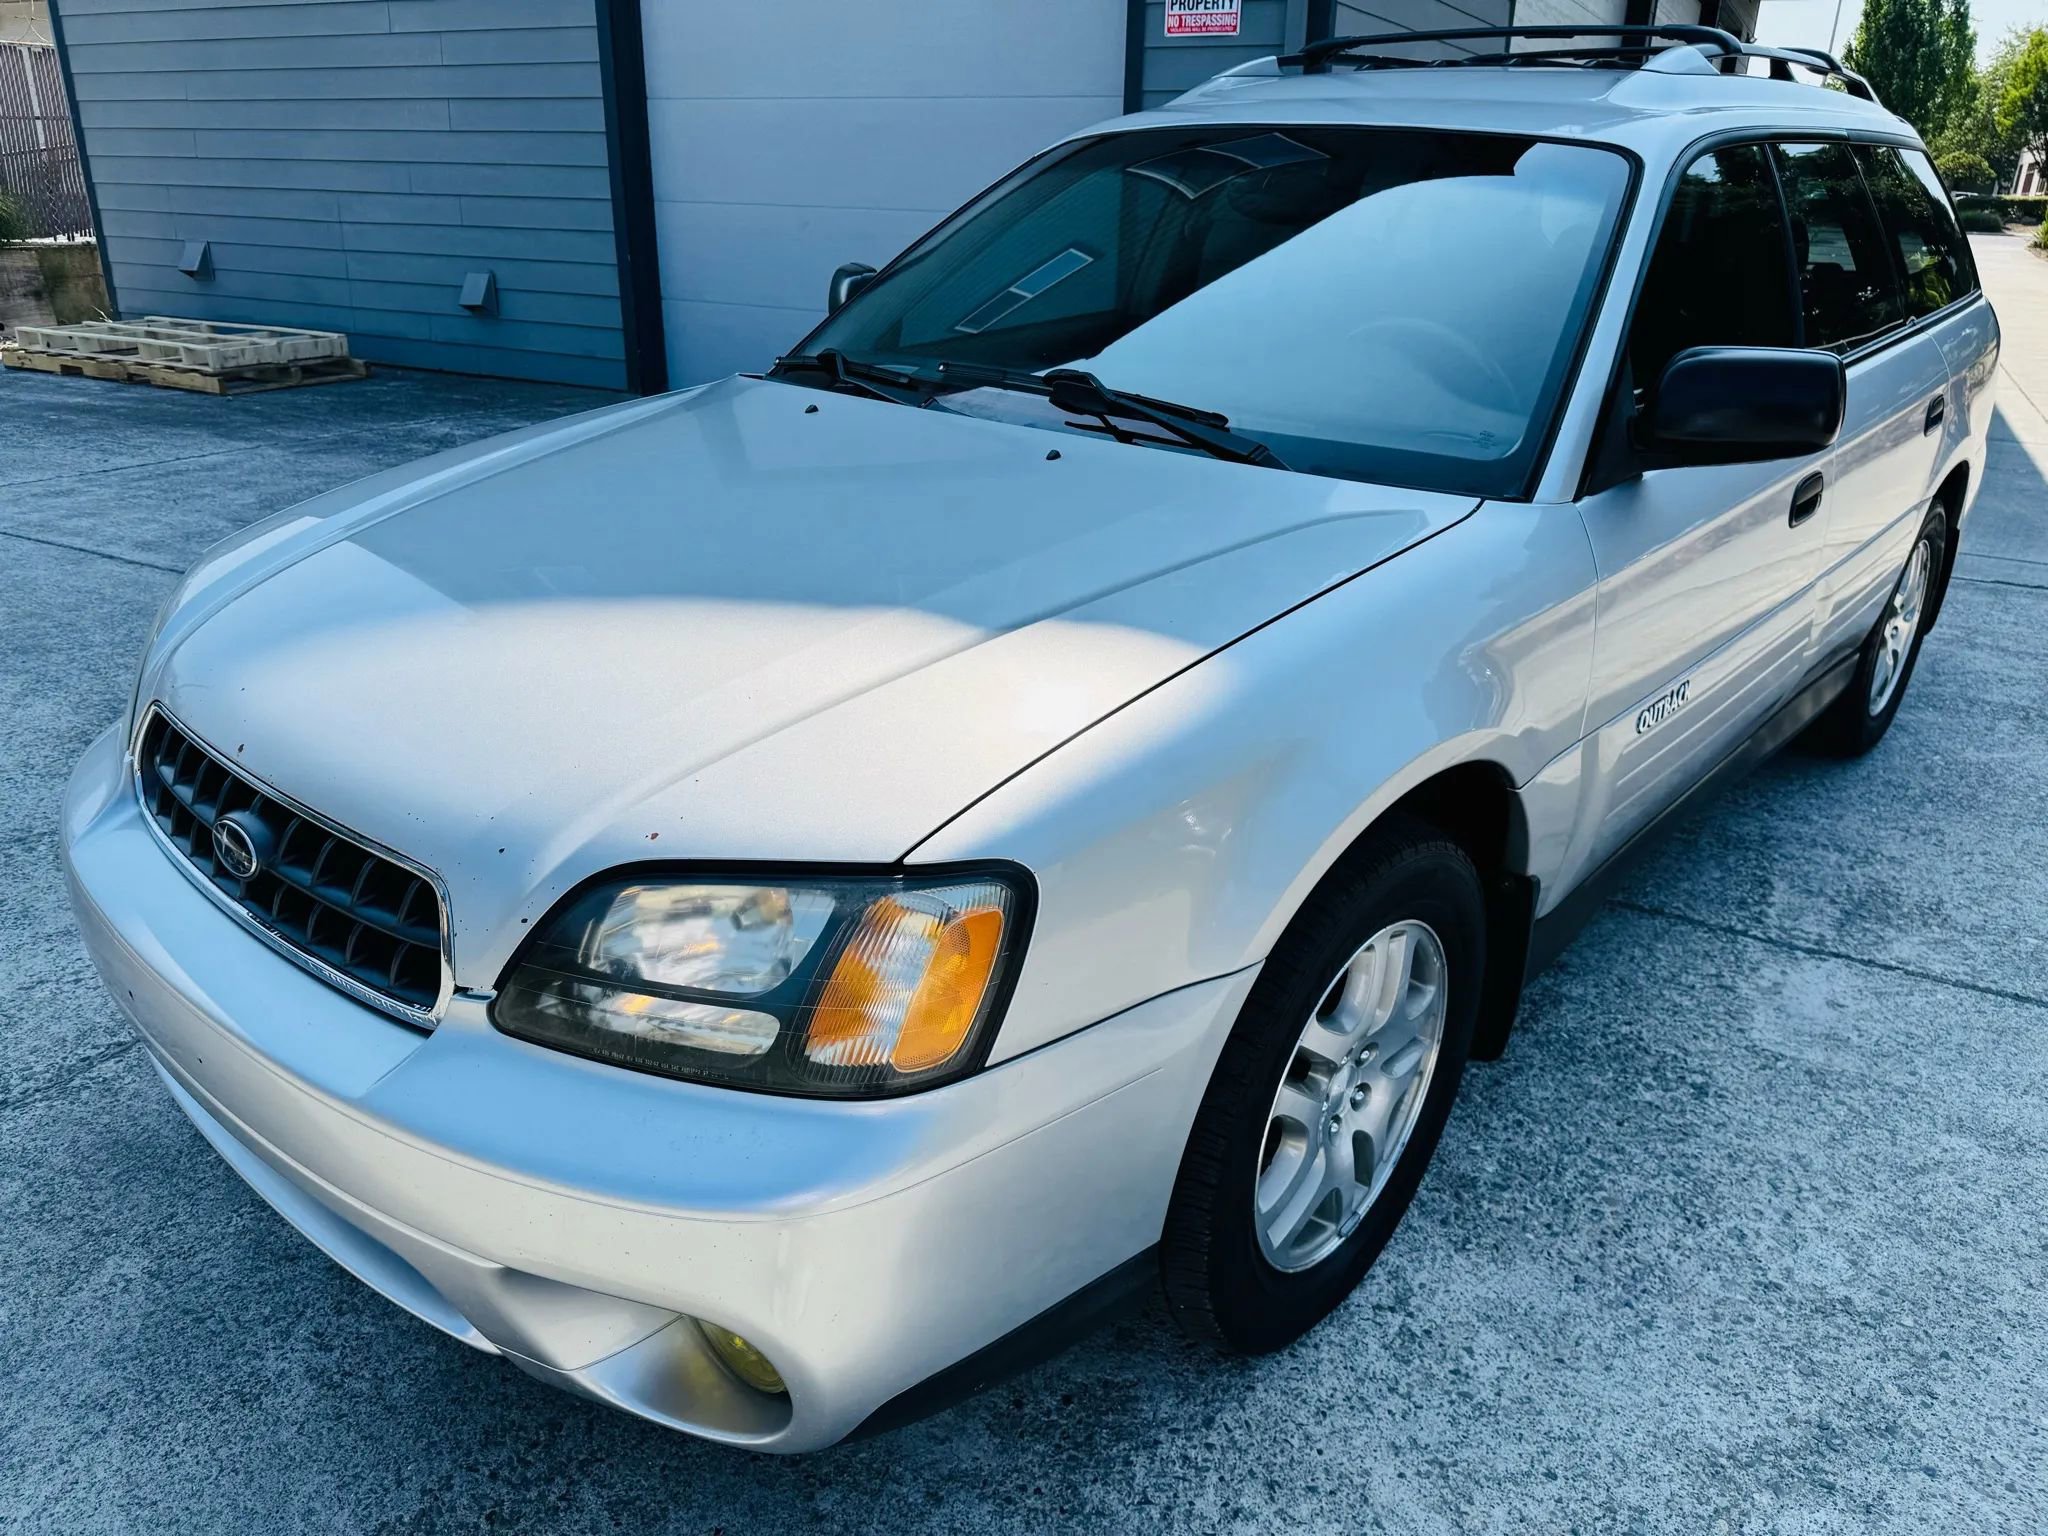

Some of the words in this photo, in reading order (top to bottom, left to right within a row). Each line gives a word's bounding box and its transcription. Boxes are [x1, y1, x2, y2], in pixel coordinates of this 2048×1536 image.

[1170, 0, 1234, 11] PROPERTY
[1168, 15, 1179, 27] NO
[1181, 14, 1237, 27] TRESPASSING
[1636, 680, 1690, 734] OUTBACK
